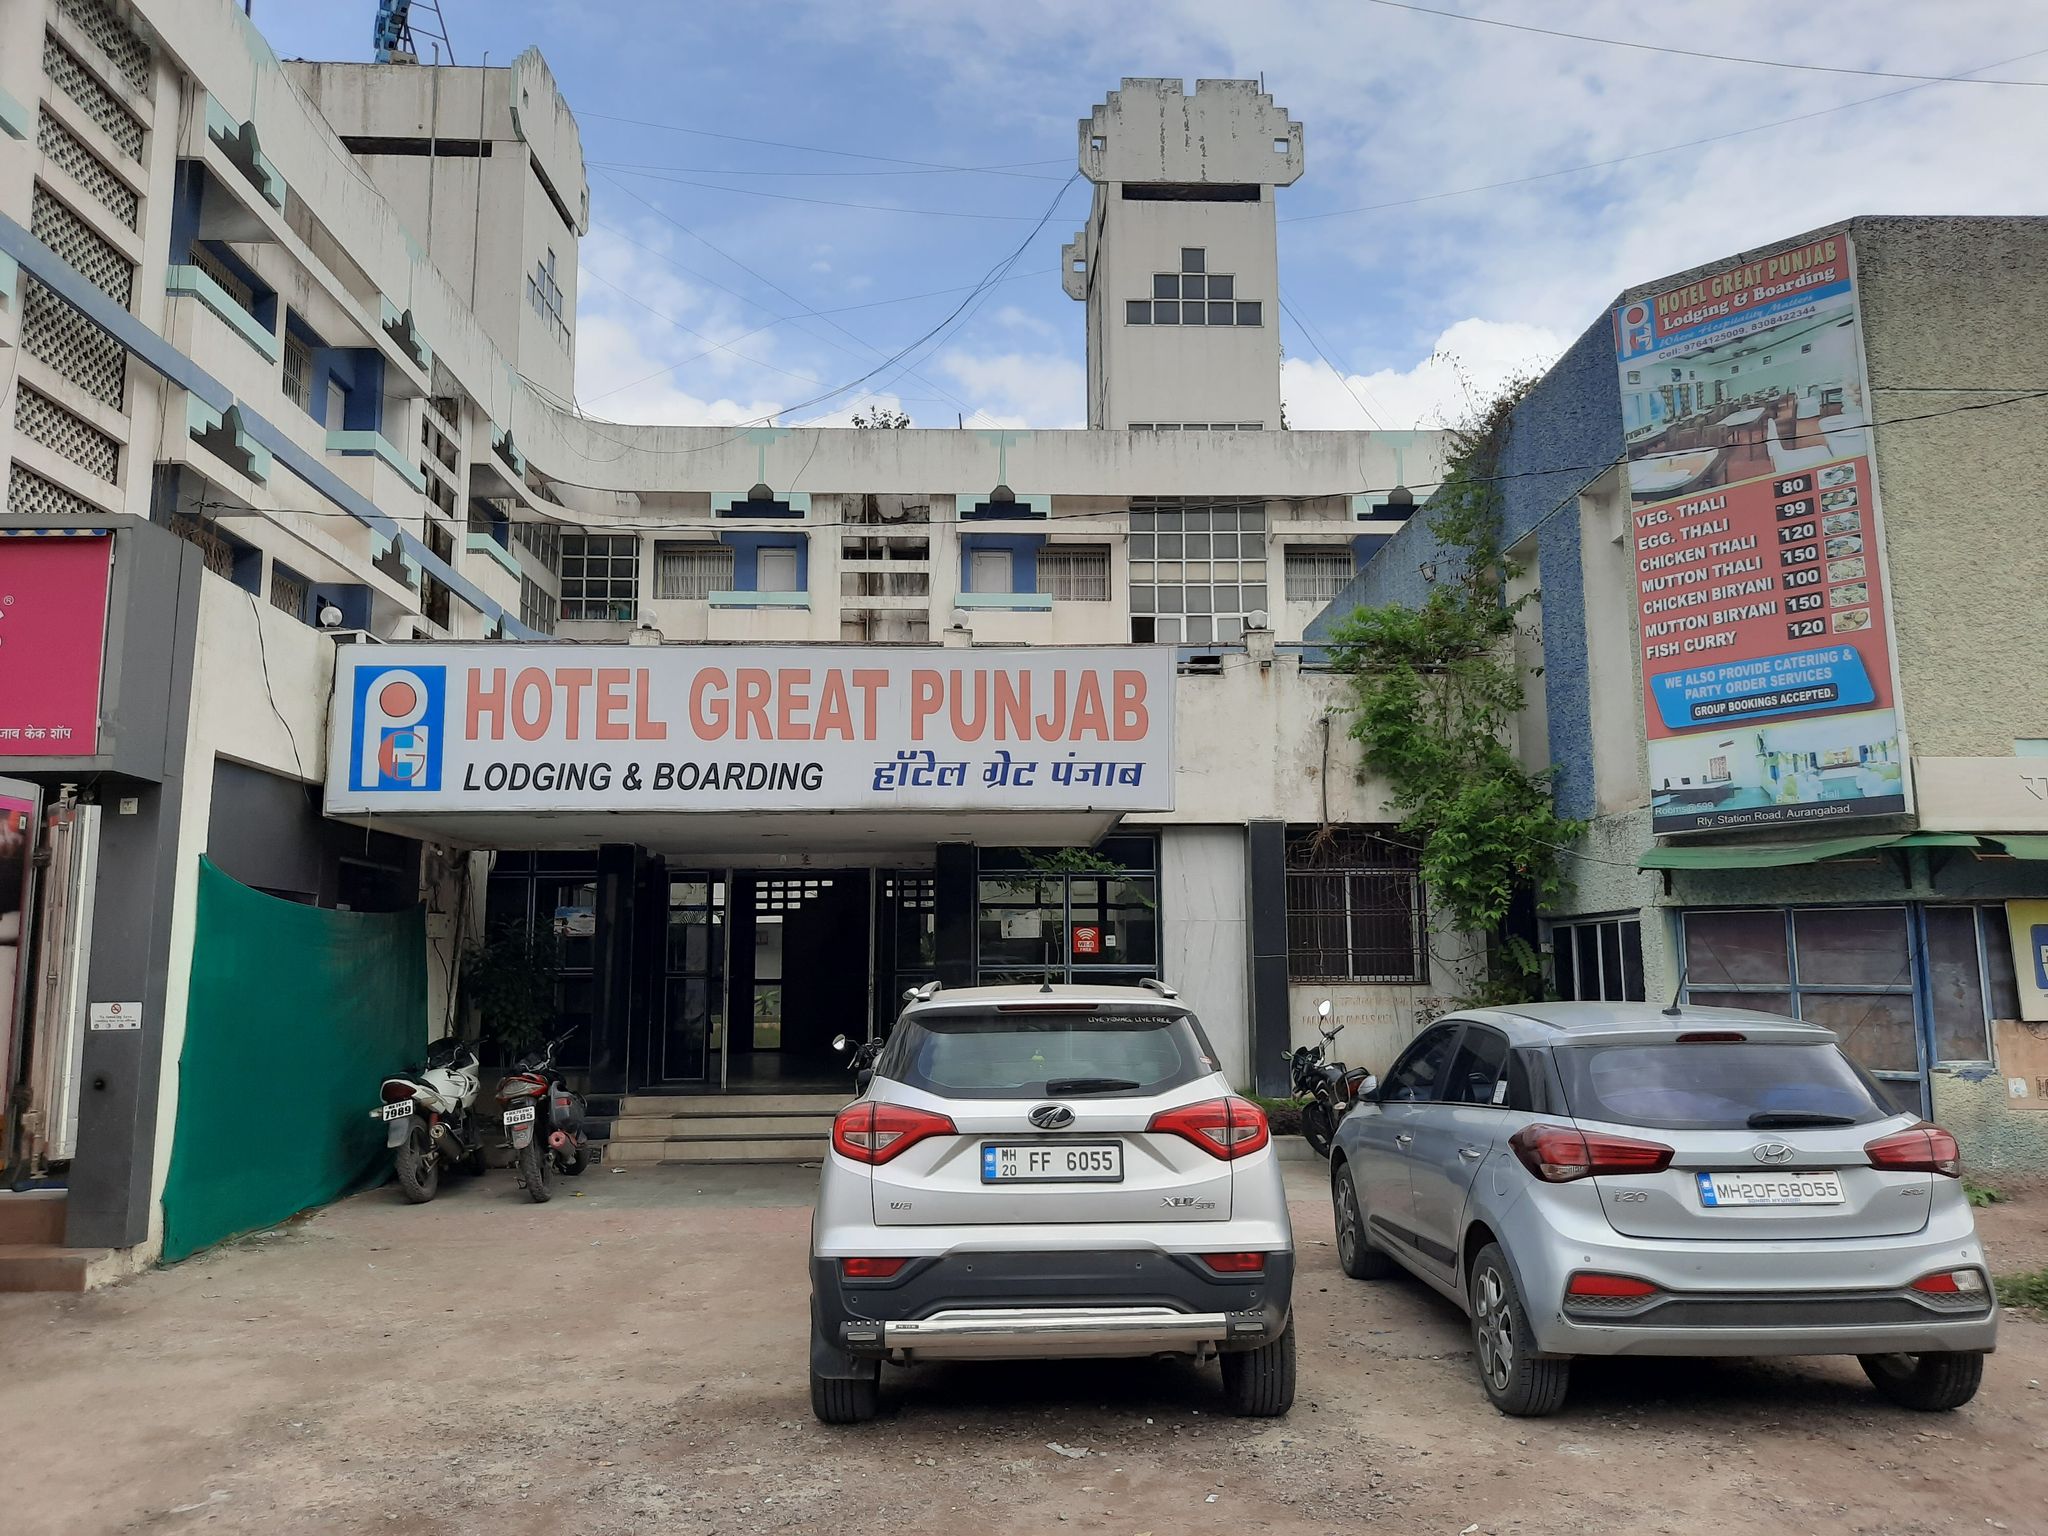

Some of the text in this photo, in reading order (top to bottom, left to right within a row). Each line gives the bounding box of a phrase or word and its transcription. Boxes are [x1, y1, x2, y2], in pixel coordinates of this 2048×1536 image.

[1658, 241, 1837, 317] HOTEL GREAT PUNJAB
[1663, 265, 1837, 331] Lodging & Boarding
[1751, 305, 1816, 331] 8308422344
[1782, 478, 1804, 494] 80
[1636, 495, 1727, 529] VEG. THALI
[1784, 501, 1806, 516] 99
[1638, 518, 1729, 551] EGG. THALI
[1781, 524, 1814, 541] 120
[1639, 534, 1757, 573] CHICKEN THALI
[1784, 546, 1816, 564] 150
[1641, 556, 1762, 593] MUTTON THALI
[1785, 569, 1819, 588] 100
[1643, 576, 1775, 615] CHICKEN BIRYANI
[1788, 594, 1822, 612] 150
[1645, 601, 1778, 638] MUTTON BIRYANI
[1790, 620, 1824, 637] 120
[1646, 630, 1738, 659] FISH CURRY
[1665, 649, 1853, 689] WE ALSO PROVIDE CATERING &
[1685, 667, 1832, 701] PARTY ORDER SERVICES
[464, 665, 1150, 743] HOTEL GREAT PUNJAB
[1694, 688, 1835, 718] GROUP BOOKINGS ACCEPTED.
[24, 725, 46, 740] केक
[50, 725, 73, 740] शॉप
[462, 762, 824, 791] LODGING & BOARDING
[871, 750, 1147, 791] हॉटेल ग्रेट पंजाब
[1697, 816, 1714, 827] Rly.
[1717, 813, 1751, 825] Station
[385, 1105, 411, 1120] 7989
[506, 1112, 533, 1123] 9685
[1001, 1149, 1113, 1172] MH FF 6055
[1002, 1164, 1017, 1176] 20
[1716, 1182, 1839, 1199] MH20FG8055
